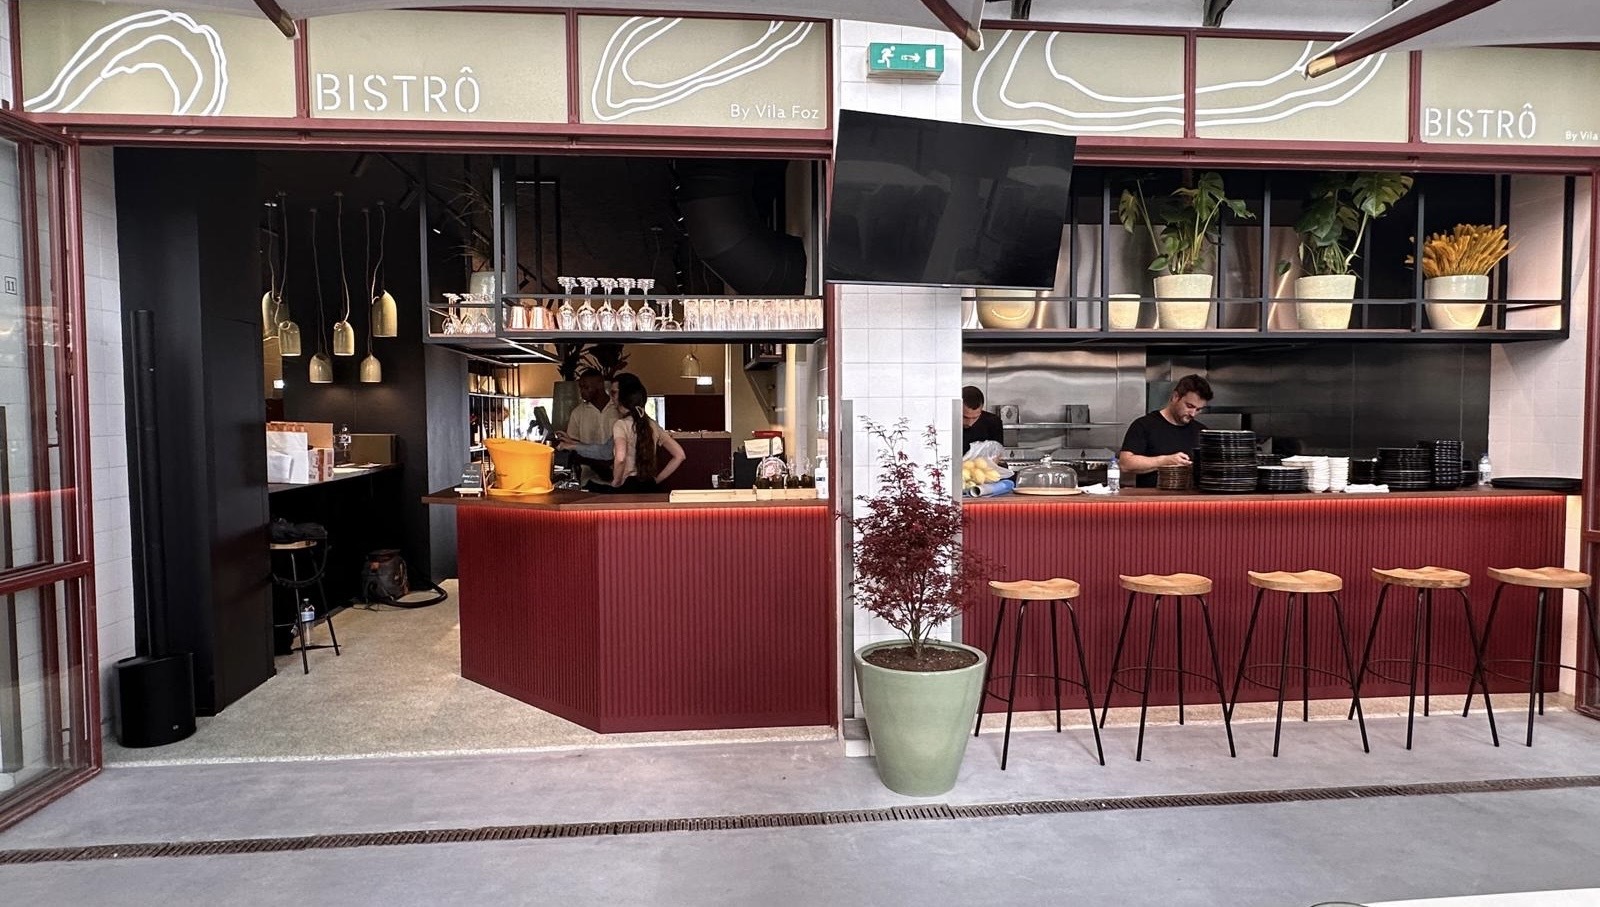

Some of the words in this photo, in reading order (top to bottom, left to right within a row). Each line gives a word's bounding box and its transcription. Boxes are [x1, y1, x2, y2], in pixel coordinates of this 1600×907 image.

[316, 66, 480, 113] BISTRÔ
[730, 103, 750, 121] By
[755, 103, 786, 118] Vila
[792, 105, 819, 119] Foz
[1425, 102, 1536, 139] BISTRÔ
[1565, 130, 1578, 142] By
[1580, 130, 1599, 141] Vila
